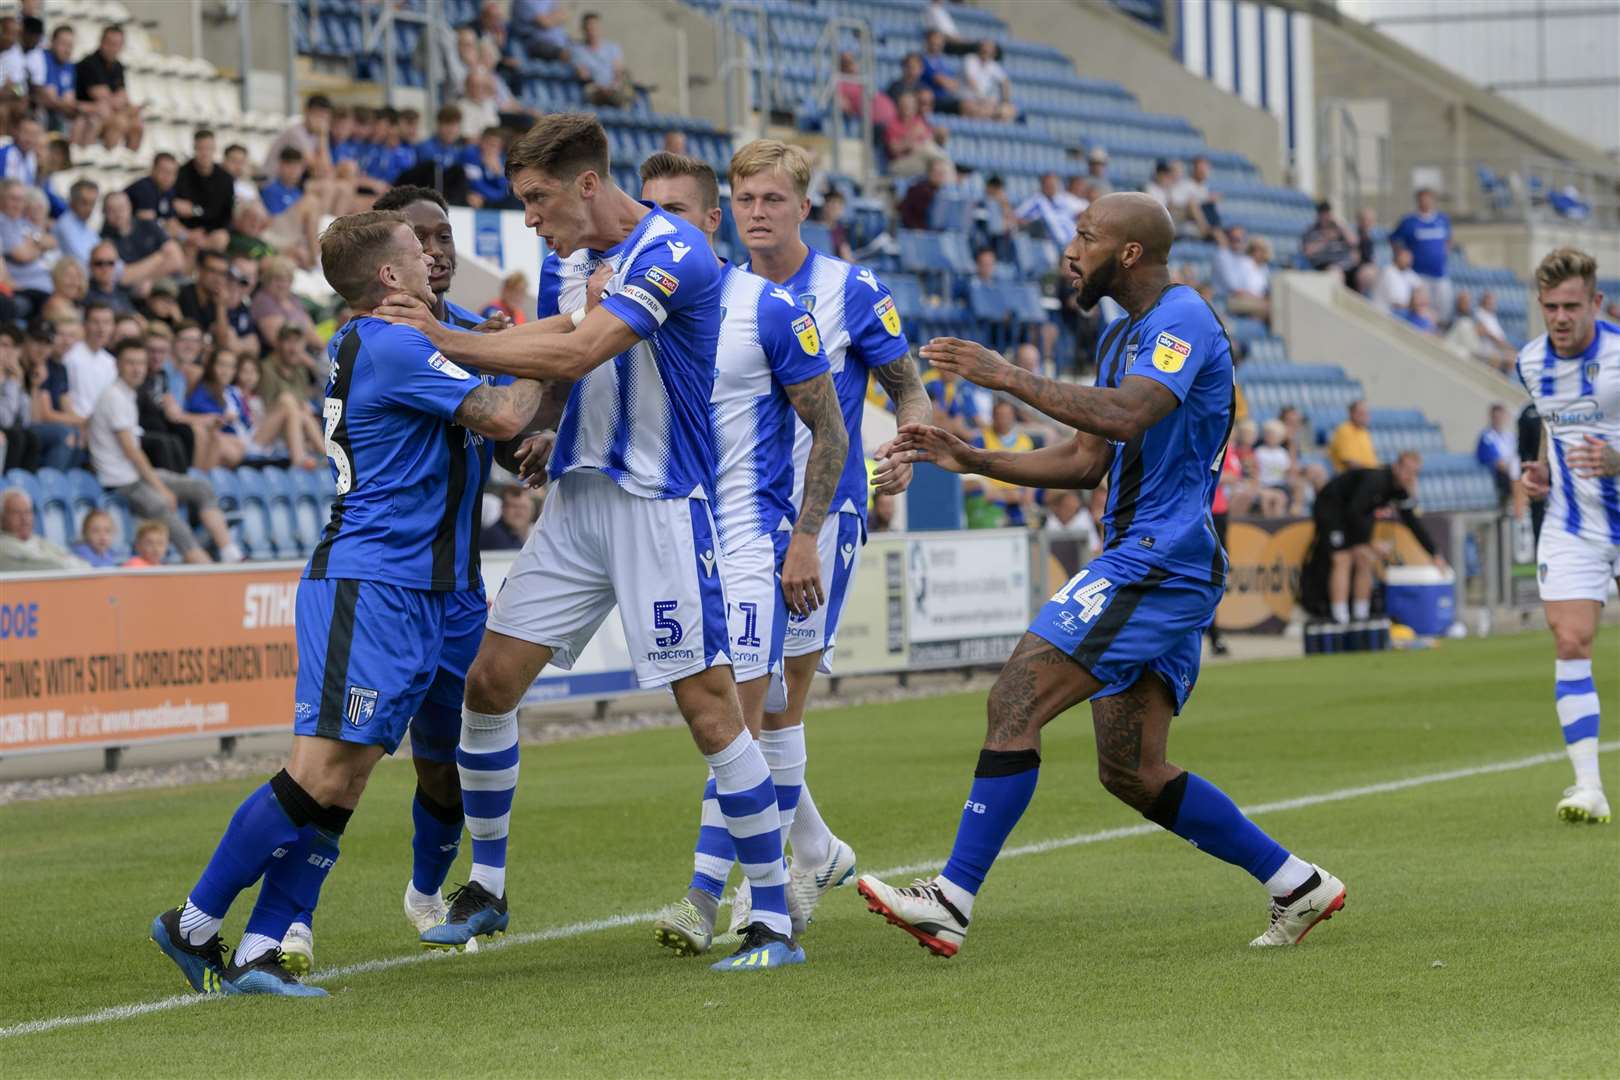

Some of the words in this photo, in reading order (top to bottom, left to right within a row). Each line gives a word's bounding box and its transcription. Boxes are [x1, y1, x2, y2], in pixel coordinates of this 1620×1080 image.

[649, 271, 662, 282] sky
[662, 277, 675, 290] bet
[634, 290, 660, 313] CAPTAIN
[1160, 336, 1173, 348] sky
[1174, 343, 1188, 355] bet
[1050, 569, 1112, 624] 14
[653, 599, 683, 647] 5
[648, 648, 694, 662] macron
[45, 656, 85, 695] WITH
[87, 652, 132, 693] STIHL
[133, 646, 204, 689] CORDLESS
[207, 643, 262, 683] GARDEN
